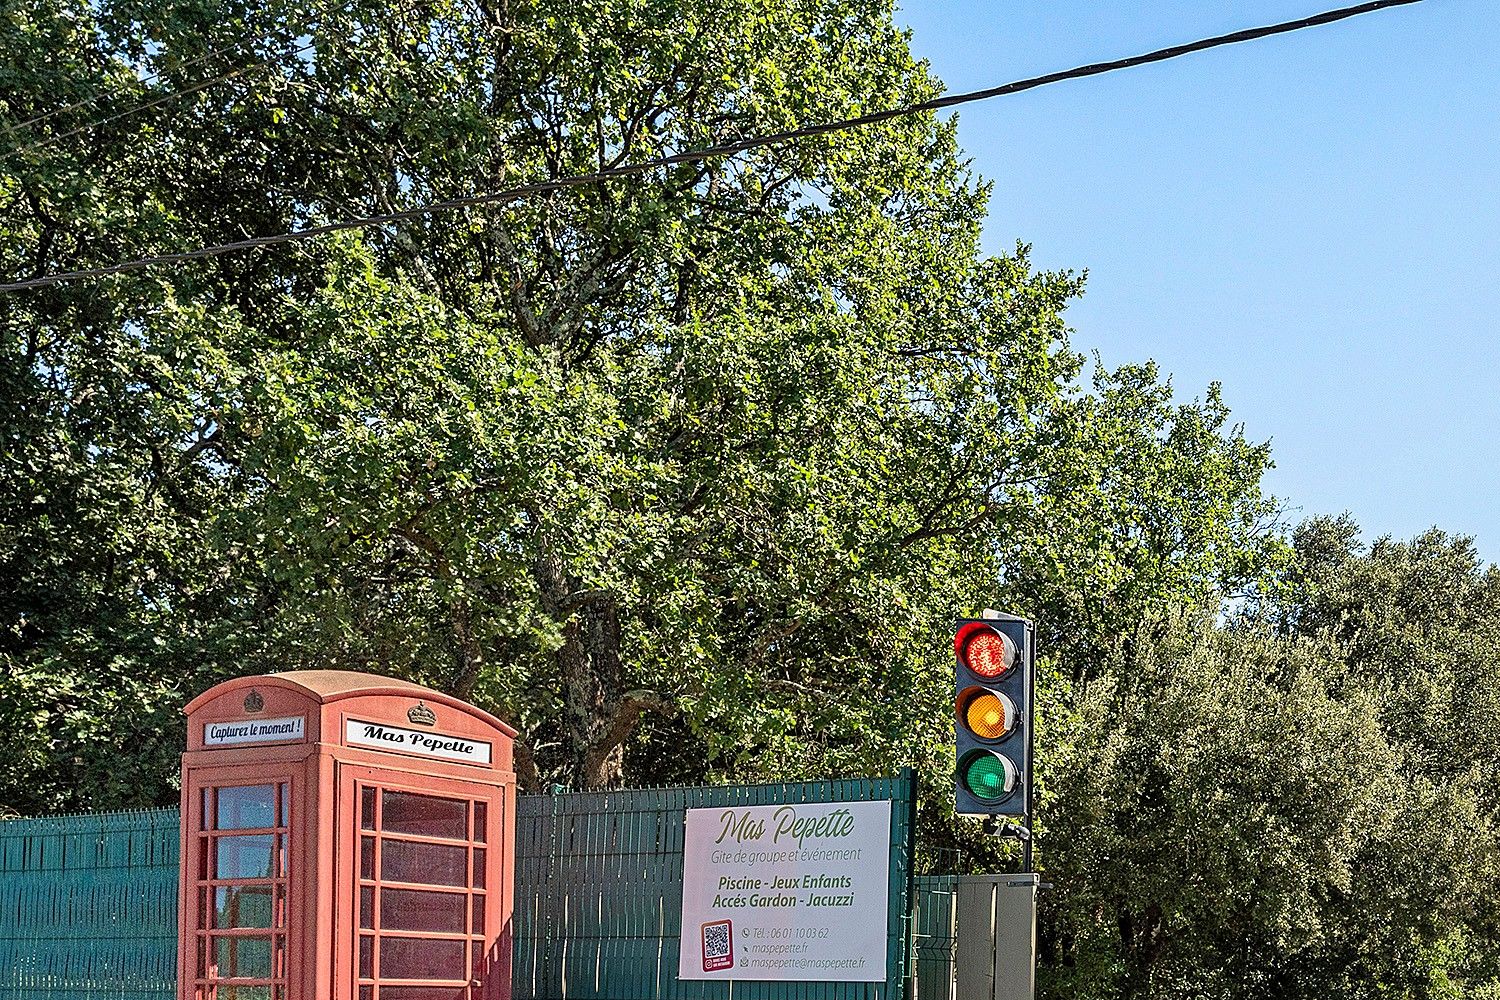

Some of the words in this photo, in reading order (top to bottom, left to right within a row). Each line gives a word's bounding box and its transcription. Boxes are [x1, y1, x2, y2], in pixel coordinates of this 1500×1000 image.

[211, 725, 248, 741] Capturez
[249, 723, 258, 736] le
[258, 721, 295, 735] moment
[297, 718, 301, 732] !
[364, 726, 404, 742] Mas
[409, 734, 474, 755] Pepette
[715, 810, 766, 844] Mas
[773, 806, 855, 849] Pepette
[733, 850, 747, 863] de
[748, 852, 787, 866] groupe
[788, 850, 799, 863] et
[801, 848, 862, 863] événement
[718, 876, 761, 890] Piscine
[770, 876, 800, 890] Jeux
[802, 874, 852, 889] Enfants
[712, 893, 746, 908] Accés
[749, 893, 796, 908] Gardon
[806, 892, 854, 907] Jacuzzi
[752, 942, 808, 955] maspepette.fr
[751, 957, 865, 970] maspepette@maspepette.fr
